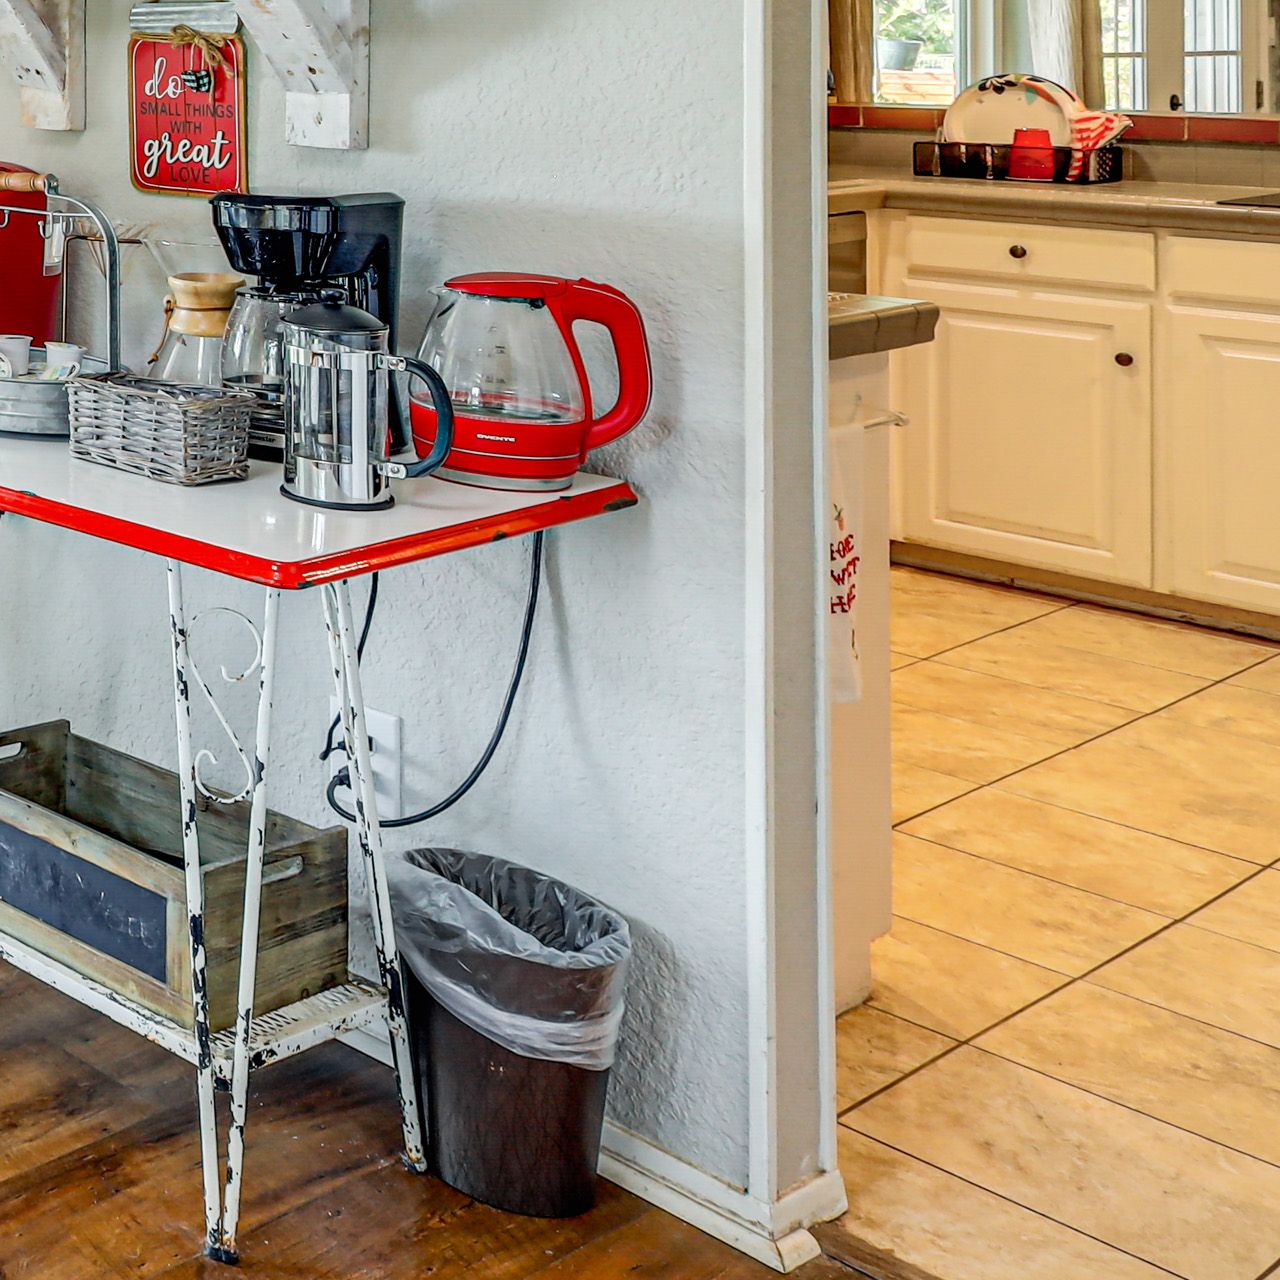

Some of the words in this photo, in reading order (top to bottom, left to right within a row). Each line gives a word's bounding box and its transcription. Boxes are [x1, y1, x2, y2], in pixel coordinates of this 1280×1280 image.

[144, 56, 186, 99] do
[140, 101, 182, 117] SMALL
[185, 102, 234, 119] THINGS
[170, 120, 202, 135] WITH
[143, 130, 231, 178] great
[170, 166, 211, 184] LOVE
